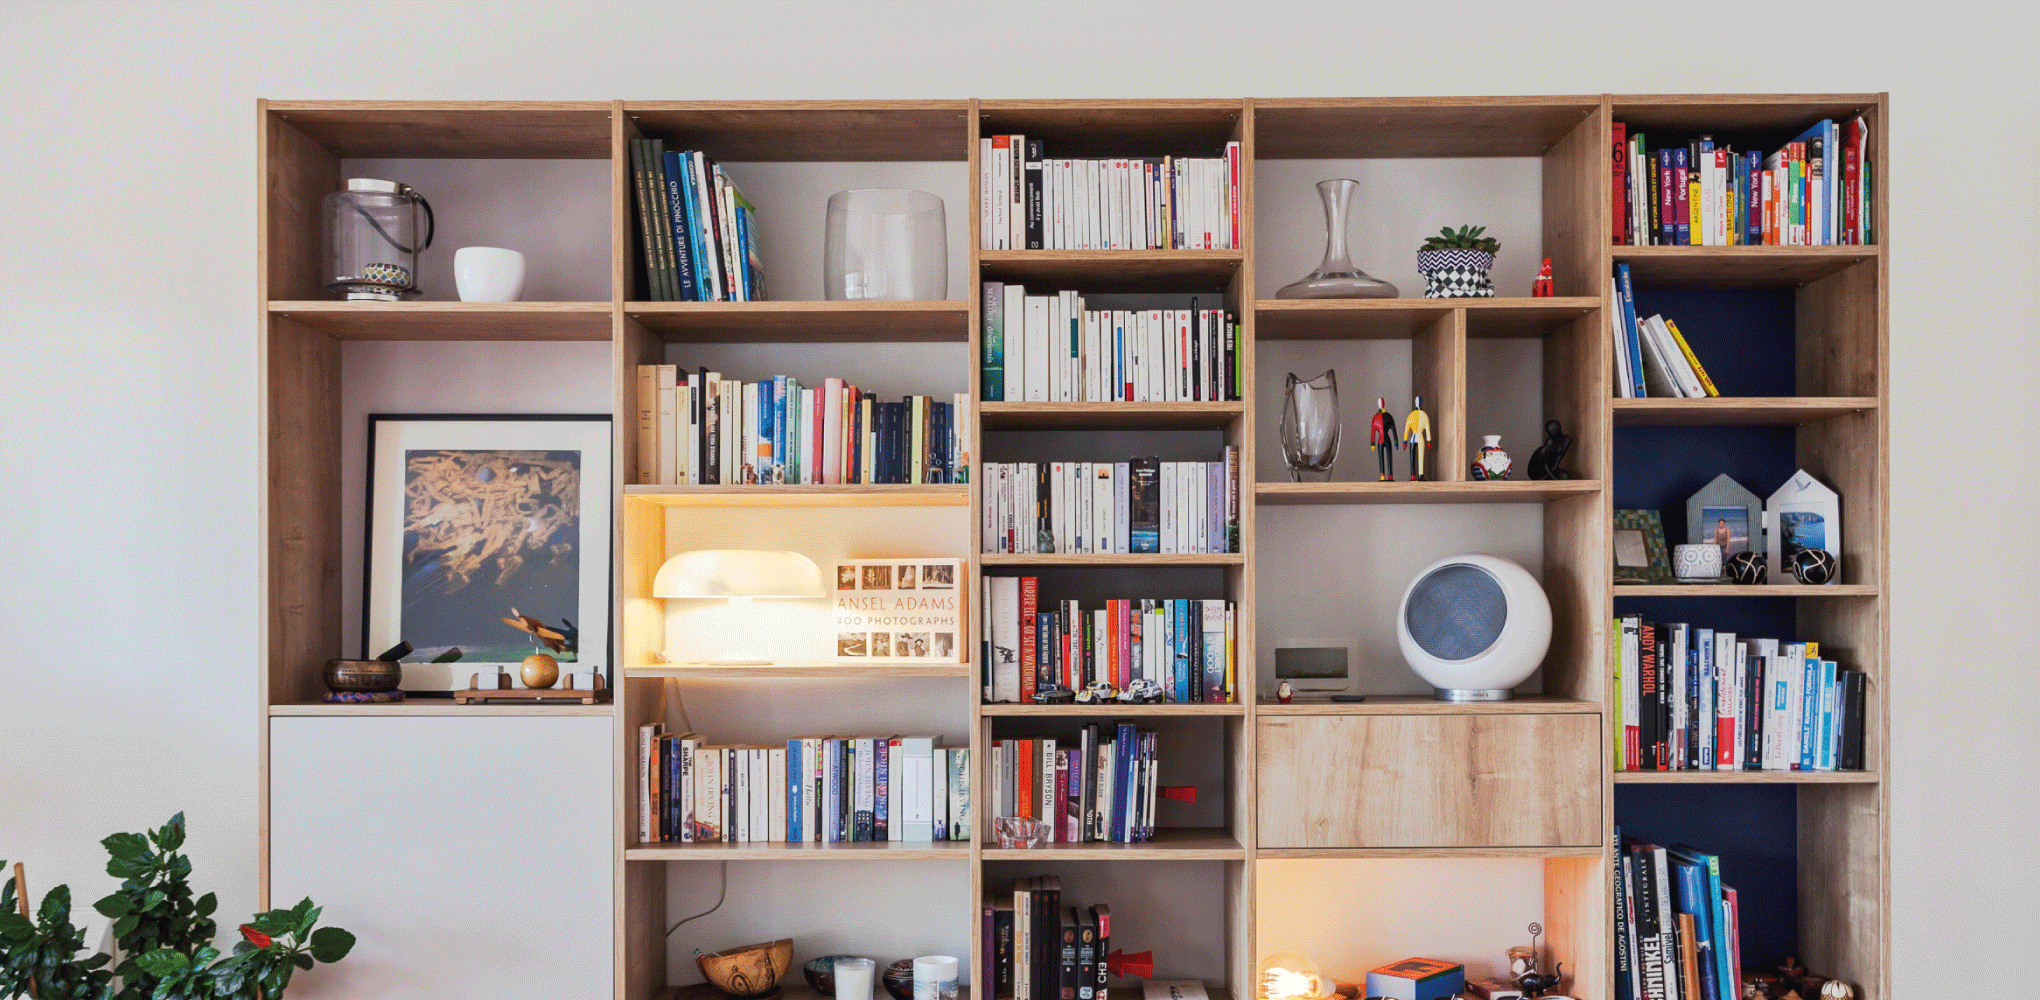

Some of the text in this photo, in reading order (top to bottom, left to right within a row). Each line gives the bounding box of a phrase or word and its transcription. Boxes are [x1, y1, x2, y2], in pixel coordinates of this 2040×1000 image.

[1612, 142, 1623, 162] 6
[688, 160, 696, 186] ODISSEA
[1678, 169, 1688, 200] Portugal
[670, 181, 691, 288] LE AVVENTURE DI PINOCCHIO
[1623, 271, 1631, 302] Escalade
[838, 597, 954, 610] ANSEL ADAMS
[1024, 581, 1034, 605] HARPER
[868, 616, 954, 625] PHOTOGRAPHS
[1024, 607, 1034, 617] LEE
[1024, 626, 1034, 634] GO
[1024, 636, 1034, 647] SET
[1206, 636, 1214, 674] ATWOOD
[1642, 625, 1656, 696] ANDY WARHOL
[1024, 655, 1034, 690] WATCHMAN
[958, 762, 966, 821] JOHN IRVING
[1045, 752, 1053, 806] BILL BRYSON
[1710, 857, 1718, 876] GEO
[1615, 870, 1623, 919] GEOGRAFICO
[1640, 858, 1651, 922] L'INTÉGRALE
[1661, 896, 1669, 906] DES
[1618, 922, 1624, 932] DE
[1619, 935, 1627, 972] AGOSTINI
[1661, 933, 1675, 964] Samivel
